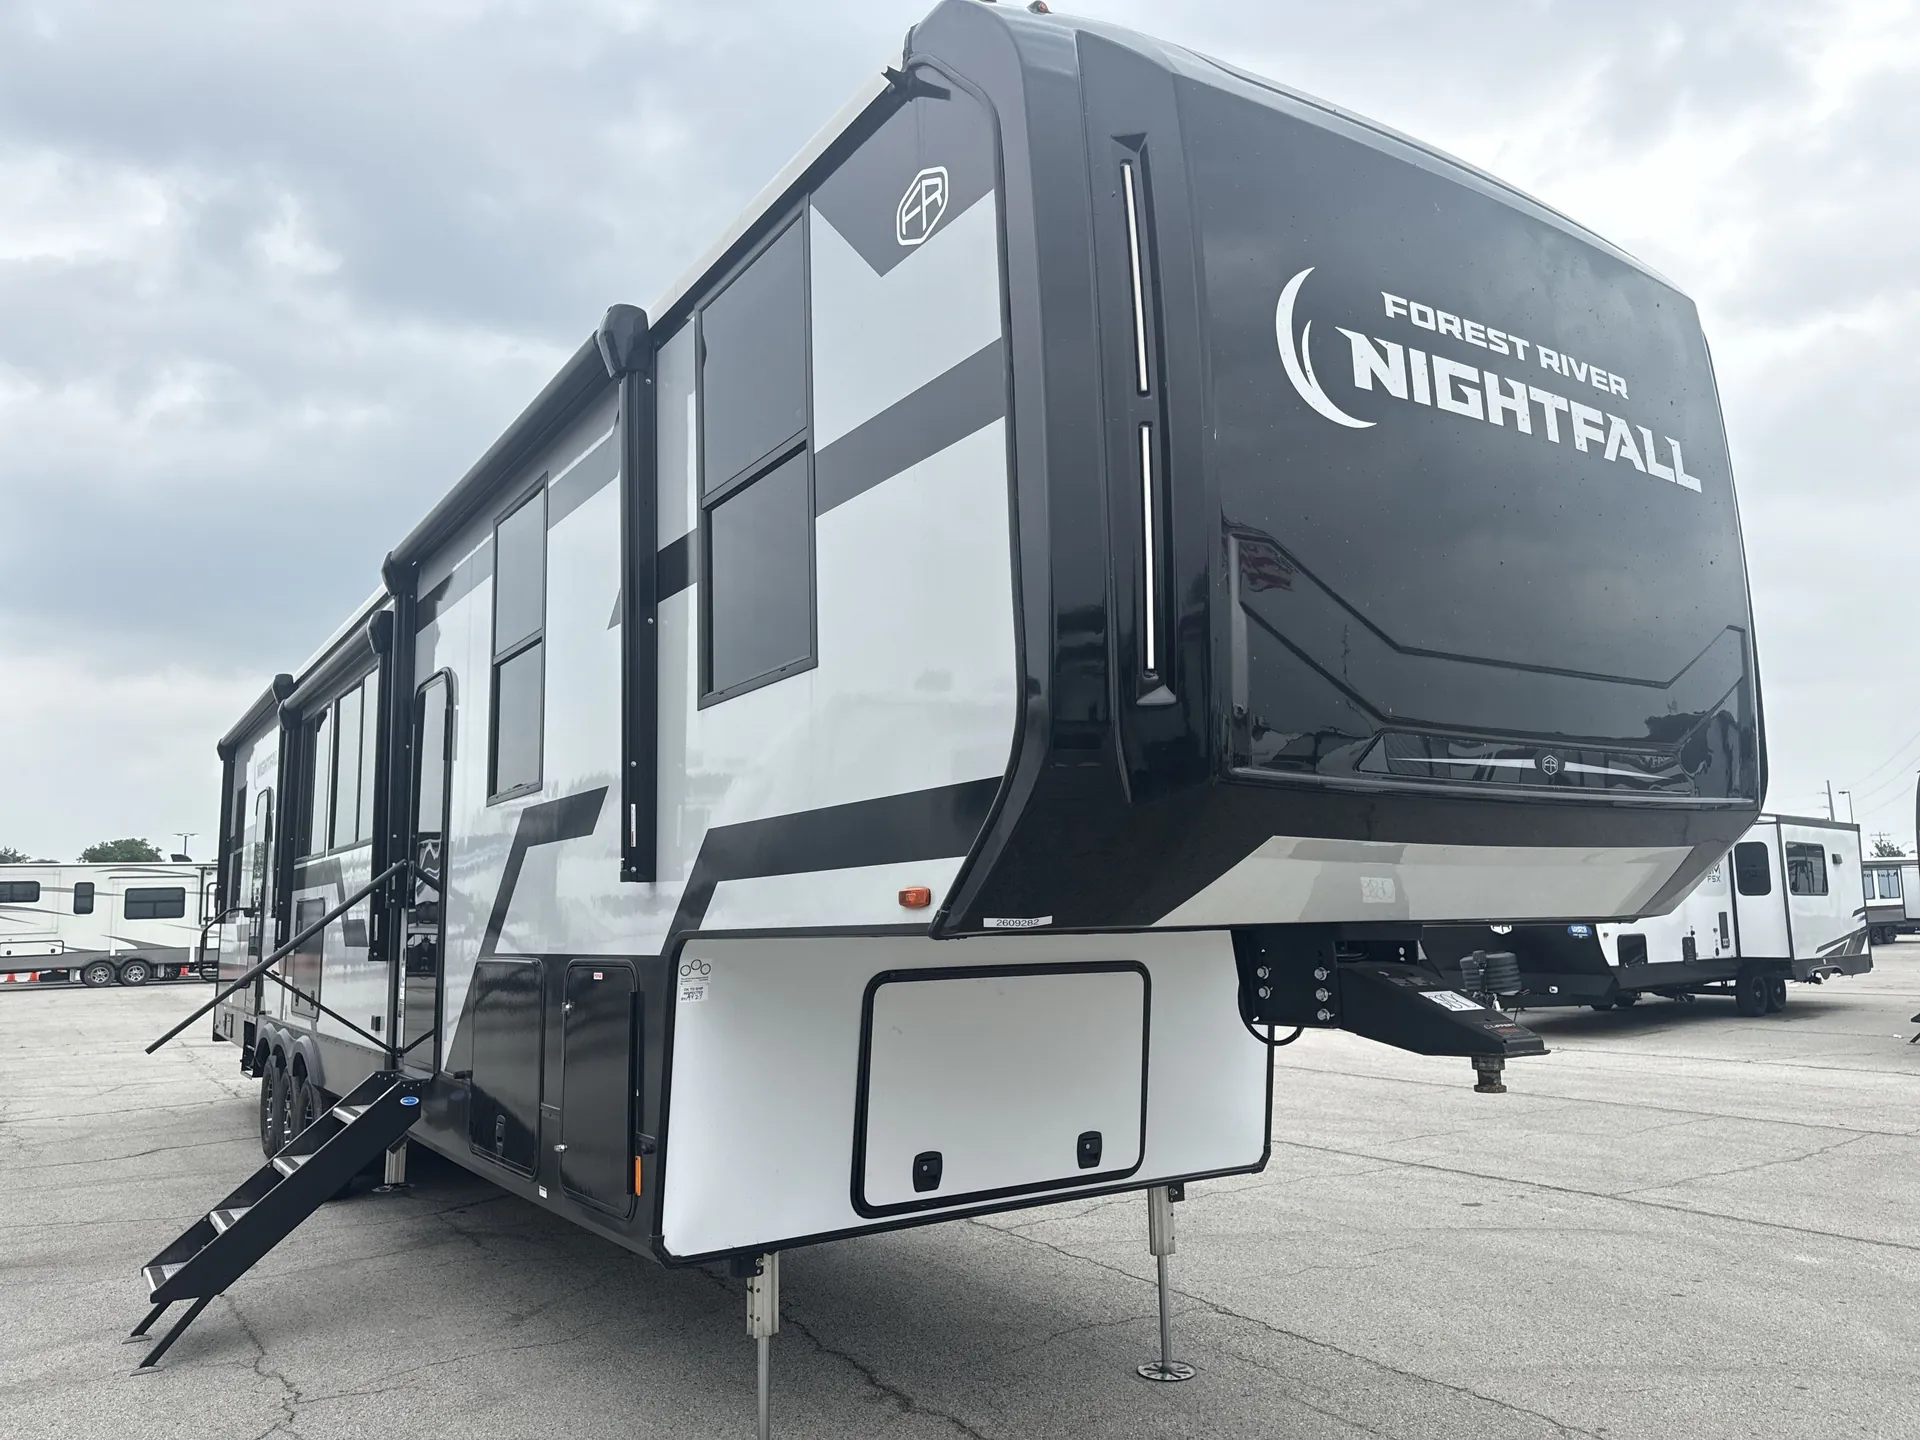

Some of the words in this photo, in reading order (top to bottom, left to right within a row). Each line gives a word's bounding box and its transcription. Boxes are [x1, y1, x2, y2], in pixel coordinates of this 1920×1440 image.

[1381, 291, 1530, 361] FOREST
[1536, 344, 1630, 400] RIVER
[1335, 326, 1702, 494] NIGHTFALL
[996, 918, 1040, 927] 2609282
